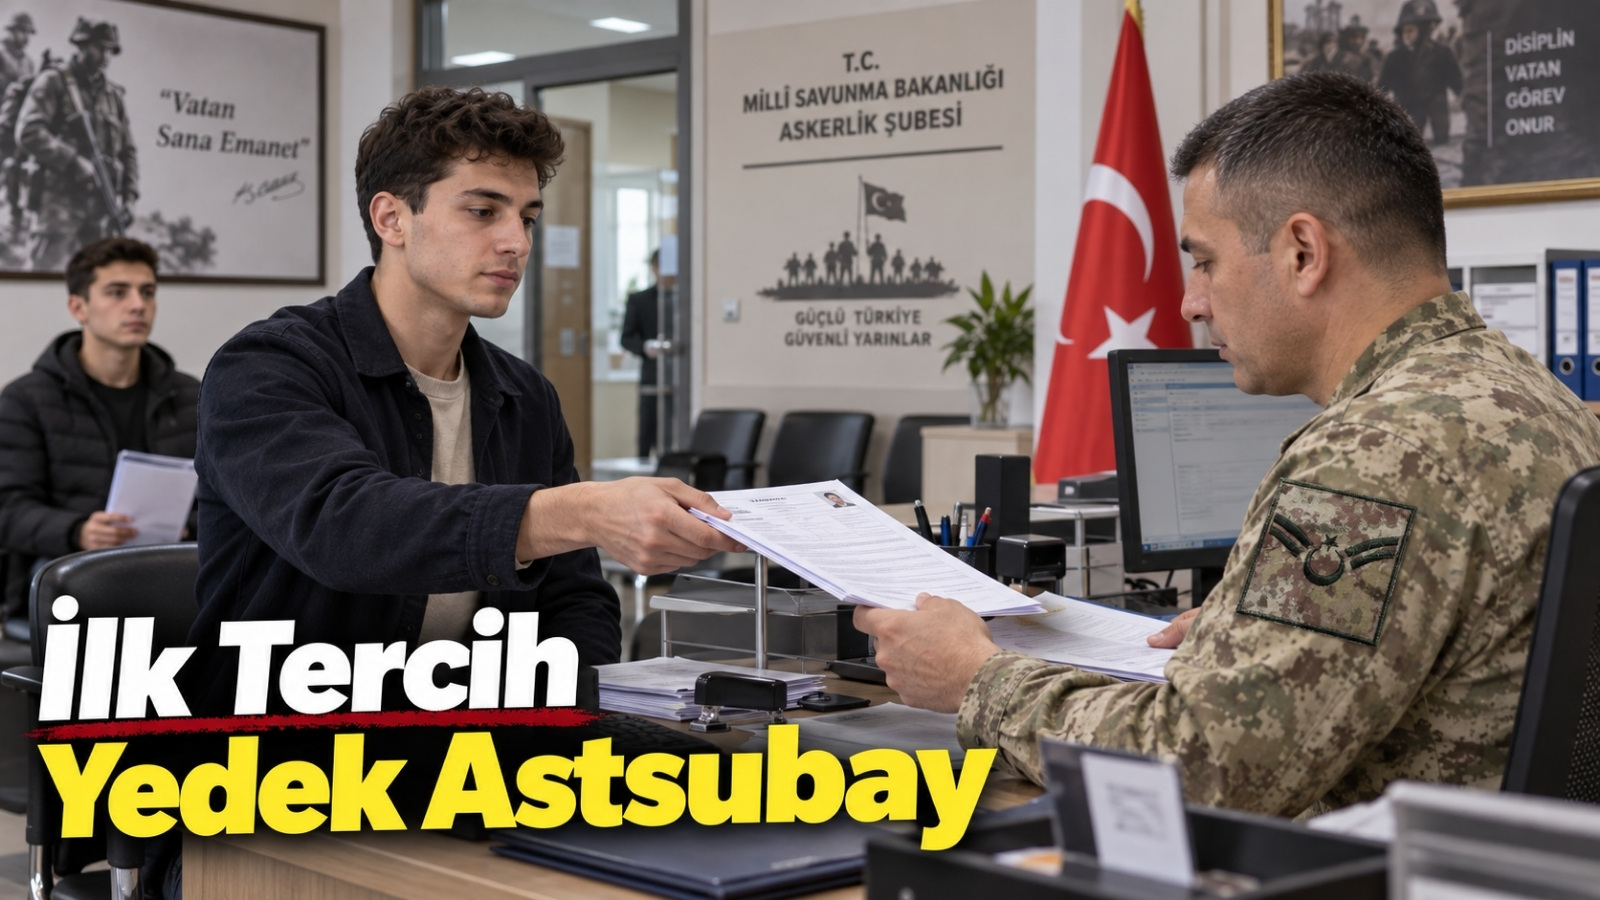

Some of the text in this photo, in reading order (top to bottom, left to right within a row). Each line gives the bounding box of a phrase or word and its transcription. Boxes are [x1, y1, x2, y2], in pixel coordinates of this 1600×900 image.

[1505, 27, 1575, 55] DİSİPLİN
[843, 51, 880, 72] T.C.
[1505, 60, 1561, 82] VATAN
[795, 80, 889, 108] SAVUNMA
[894, 64, 1004, 98] BAKANLIĞI
[1505, 86, 1566, 109] GÖREV
[779, 101, 962, 142] ASKERLİK ŞUBESİ
[1505, 115, 1555, 136] ONUR
[156, 124, 213, 152] Sana
[795, 305, 921, 327] GÜÇLÜ TÜRKİYE
[784, 328, 932, 347] GÜVENLİ YARINLAR
